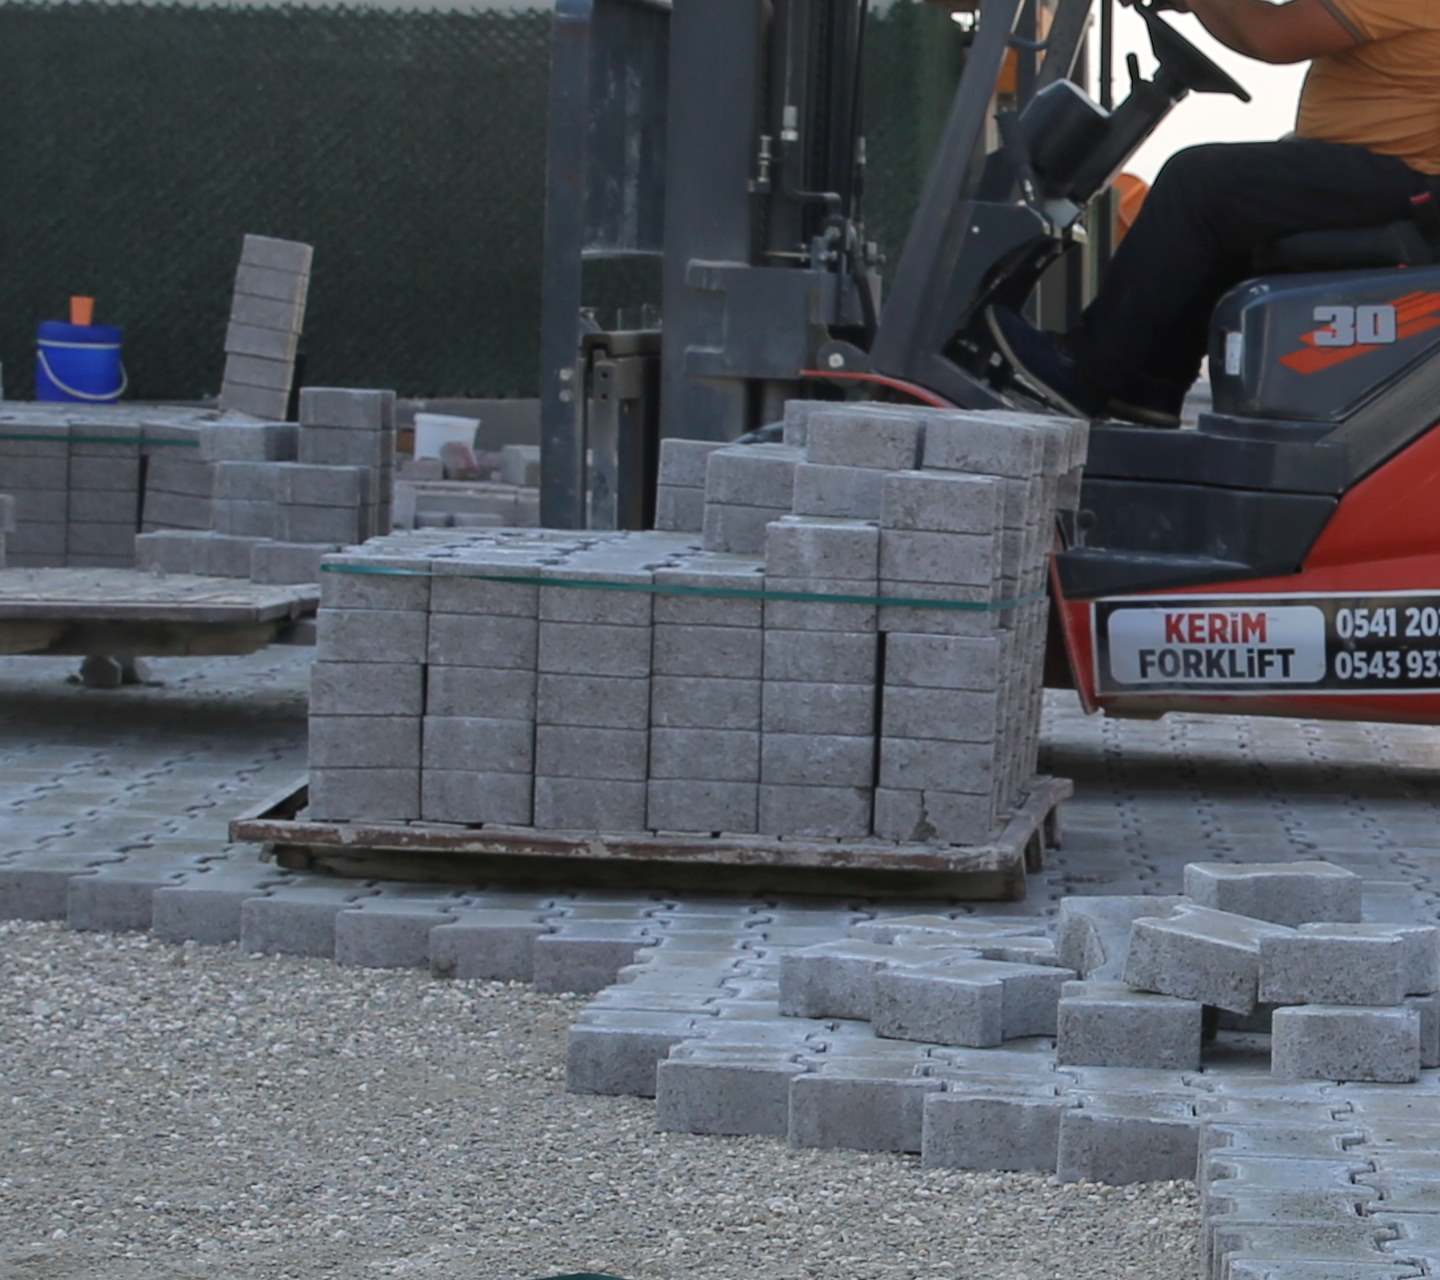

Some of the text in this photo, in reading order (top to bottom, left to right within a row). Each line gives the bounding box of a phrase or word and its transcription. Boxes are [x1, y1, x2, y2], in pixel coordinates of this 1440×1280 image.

[1313, 306, 1396, 346] 30
[1336, 607, 1397, 638] 0541
[1335, 650, 1401, 680] 0543
